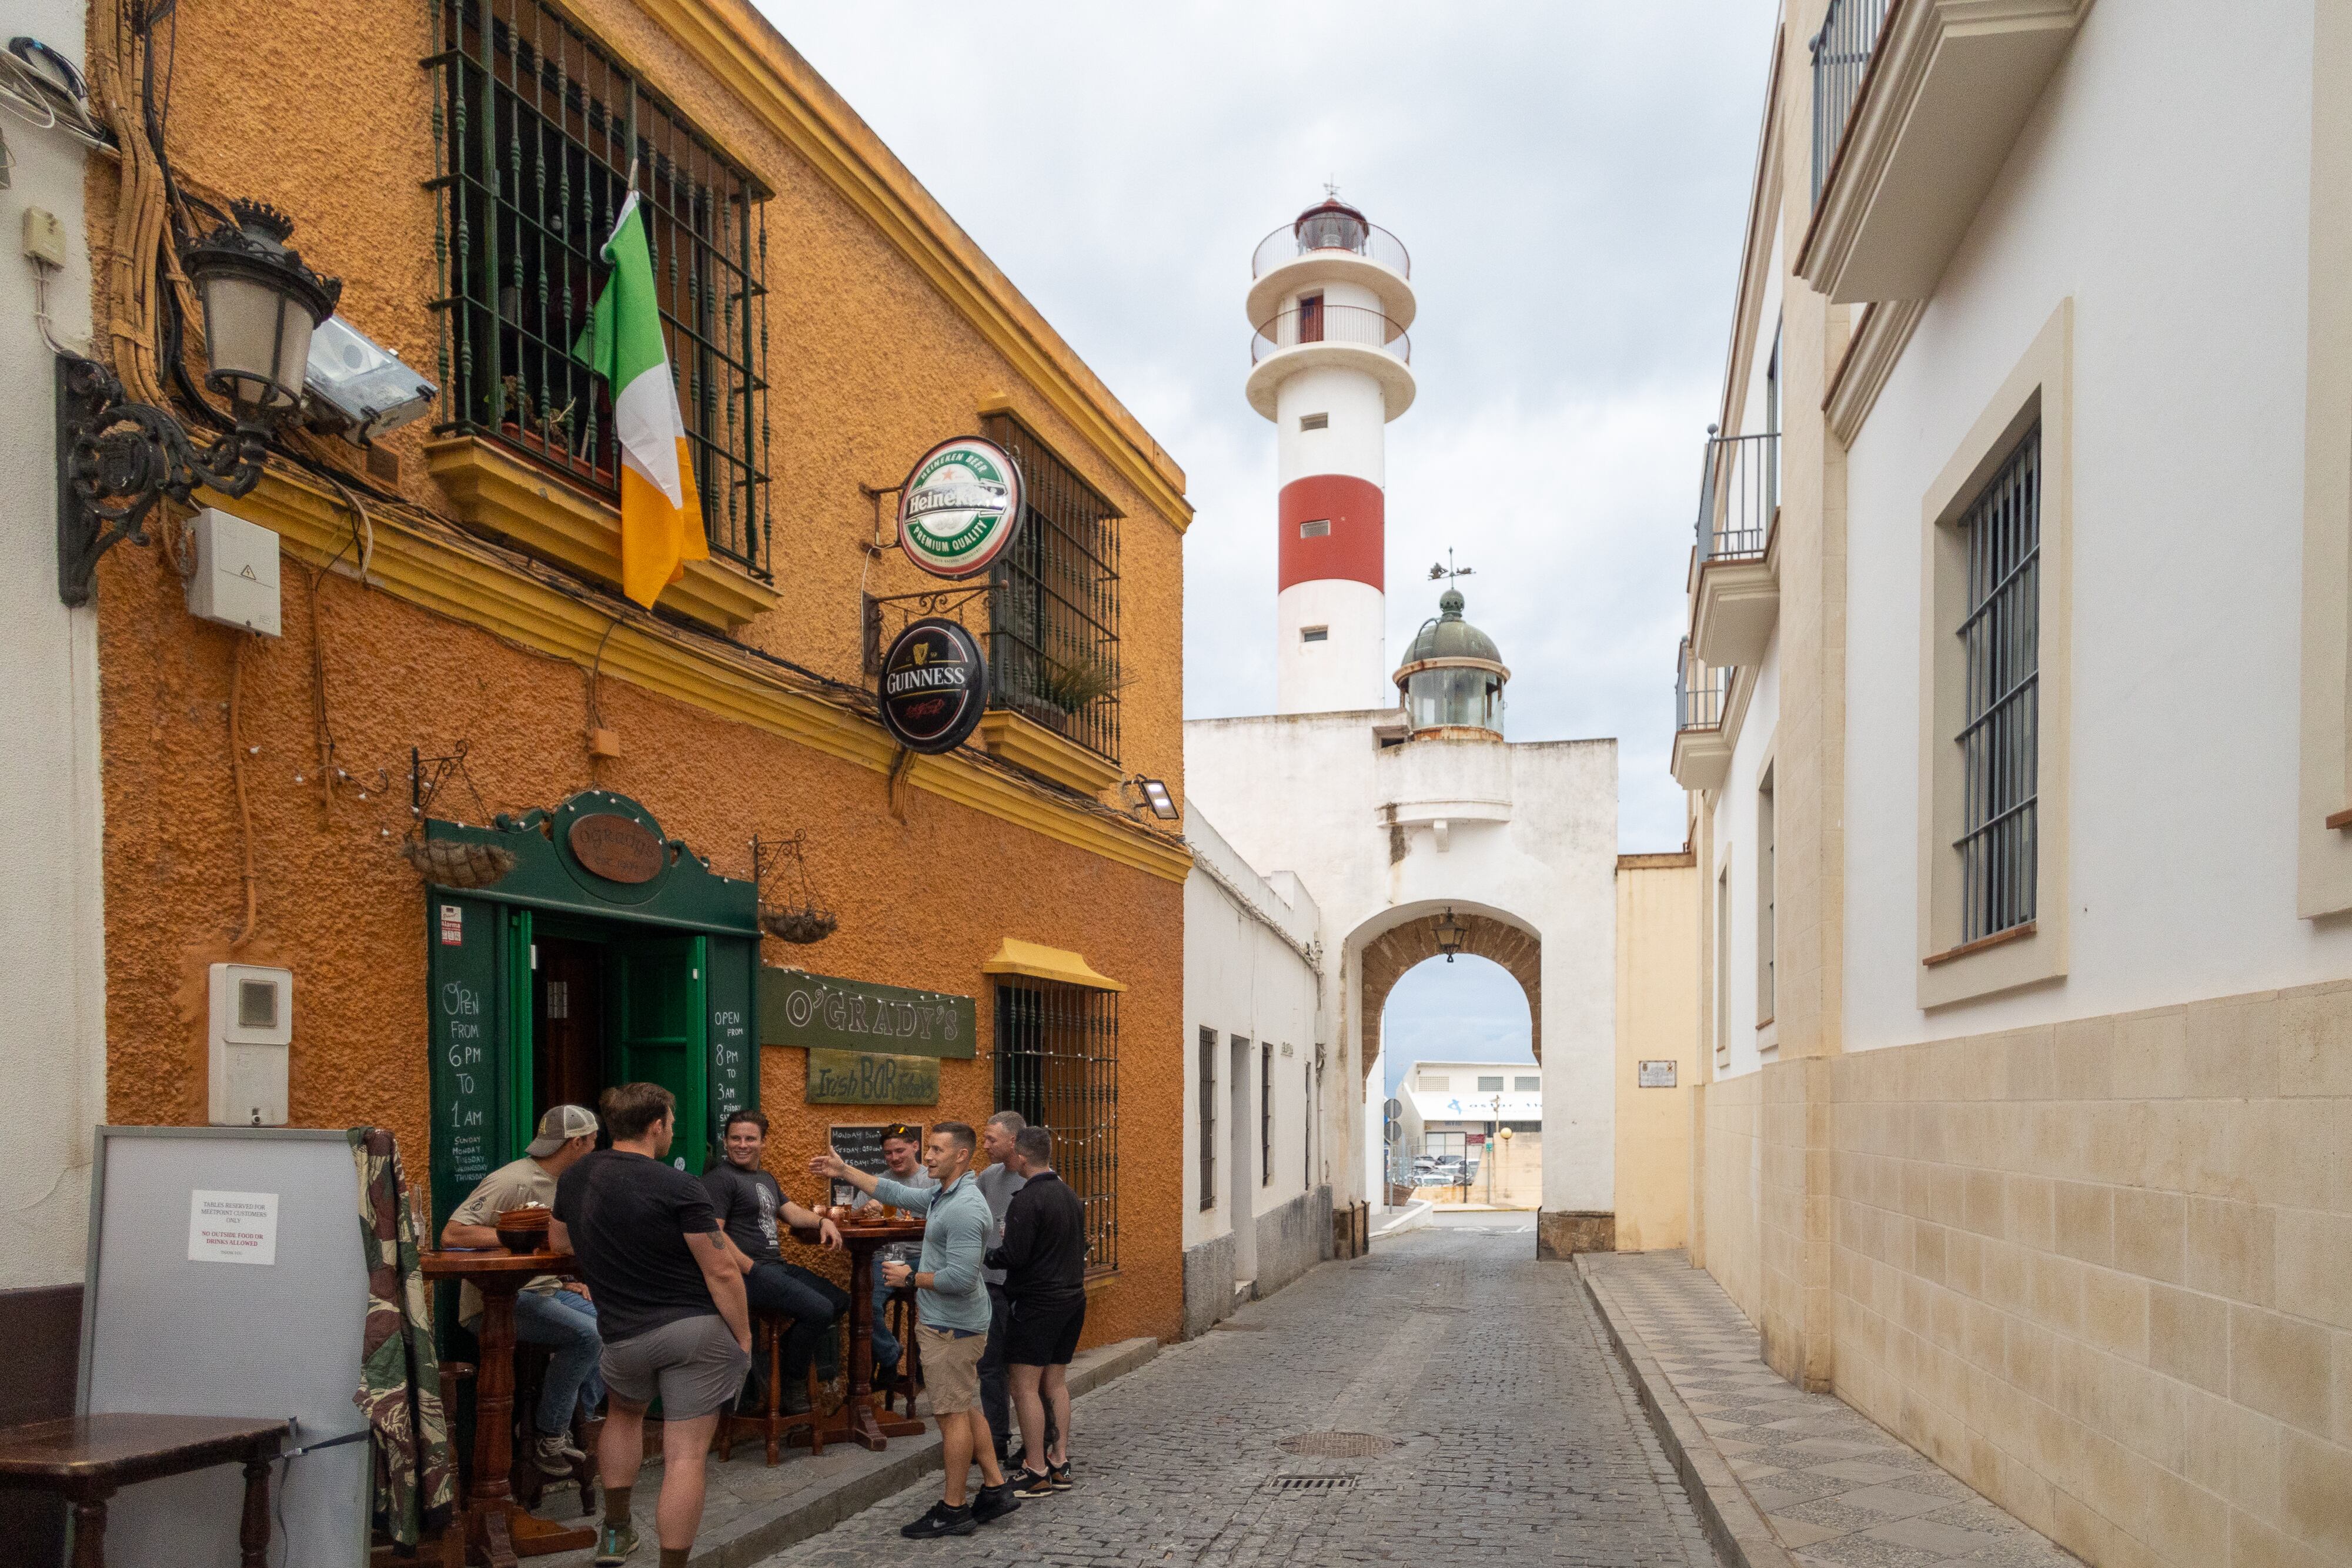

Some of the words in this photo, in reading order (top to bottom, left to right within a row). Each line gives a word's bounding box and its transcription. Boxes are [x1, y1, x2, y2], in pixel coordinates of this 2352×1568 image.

[921, 453, 964, 479] HEINEKEN
[965, 454, 987, 473] BEER
[913, 526, 950, 551] PREMIUM
[953, 519, 988, 550] QUALITY
[887, 667, 965, 694] GUINNESS
[442, 980, 479, 1015] OPEN
[714, 1011, 740, 1025] OPEN
[786, 988, 959, 1041] O'GRADY'S
[451, 1021, 479, 1039] FROM
[727, 1028, 743, 1037] FROM
[449, 1044, 462, 1066] 6
[465, 1047, 480, 1064] PM
[716, 1044, 724, 1066] 8
[726, 1050, 739, 1064] PM
[727, 1069, 736, 1078] TO
[816, 1068, 857, 1098] Irish
[456, 1073, 474, 1094] TO
[717, 1084, 724, 1101] 3
[725, 1088, 735, 1099] AM
[451, 1100, 460, 1128] 1
[464, 1111, 482, 1126] AM
[454, 1136, 480, 1145] SUNDAY
[832, 1131, 862, 1139] MONDAY
[452, 1146, 480, 1155] MONDAY
[455, 1156, 485, 1165] TUESDAY
[455, 1172, 486, 1183] THURSDAY
